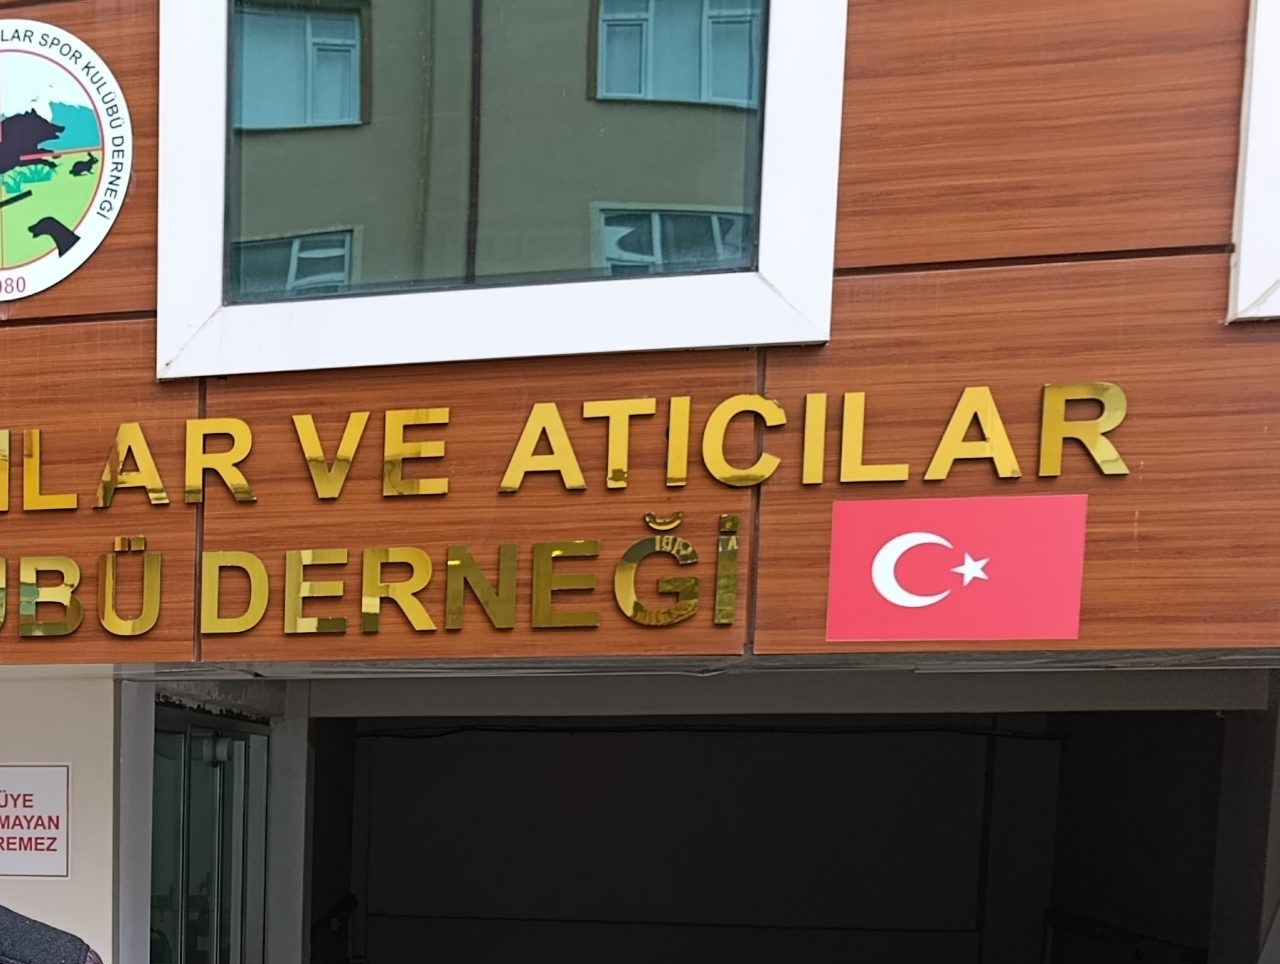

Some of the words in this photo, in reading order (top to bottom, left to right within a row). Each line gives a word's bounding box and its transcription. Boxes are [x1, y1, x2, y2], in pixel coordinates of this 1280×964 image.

[38, 33, 82, 65] SPOR
[81, 60, 125, 129] KULÜBÜ
[292, 407, 450, 499] VE
[498, 381, 1130, 493] ATICILAR
[201, 511, 740, 635] DERNEĞİ
